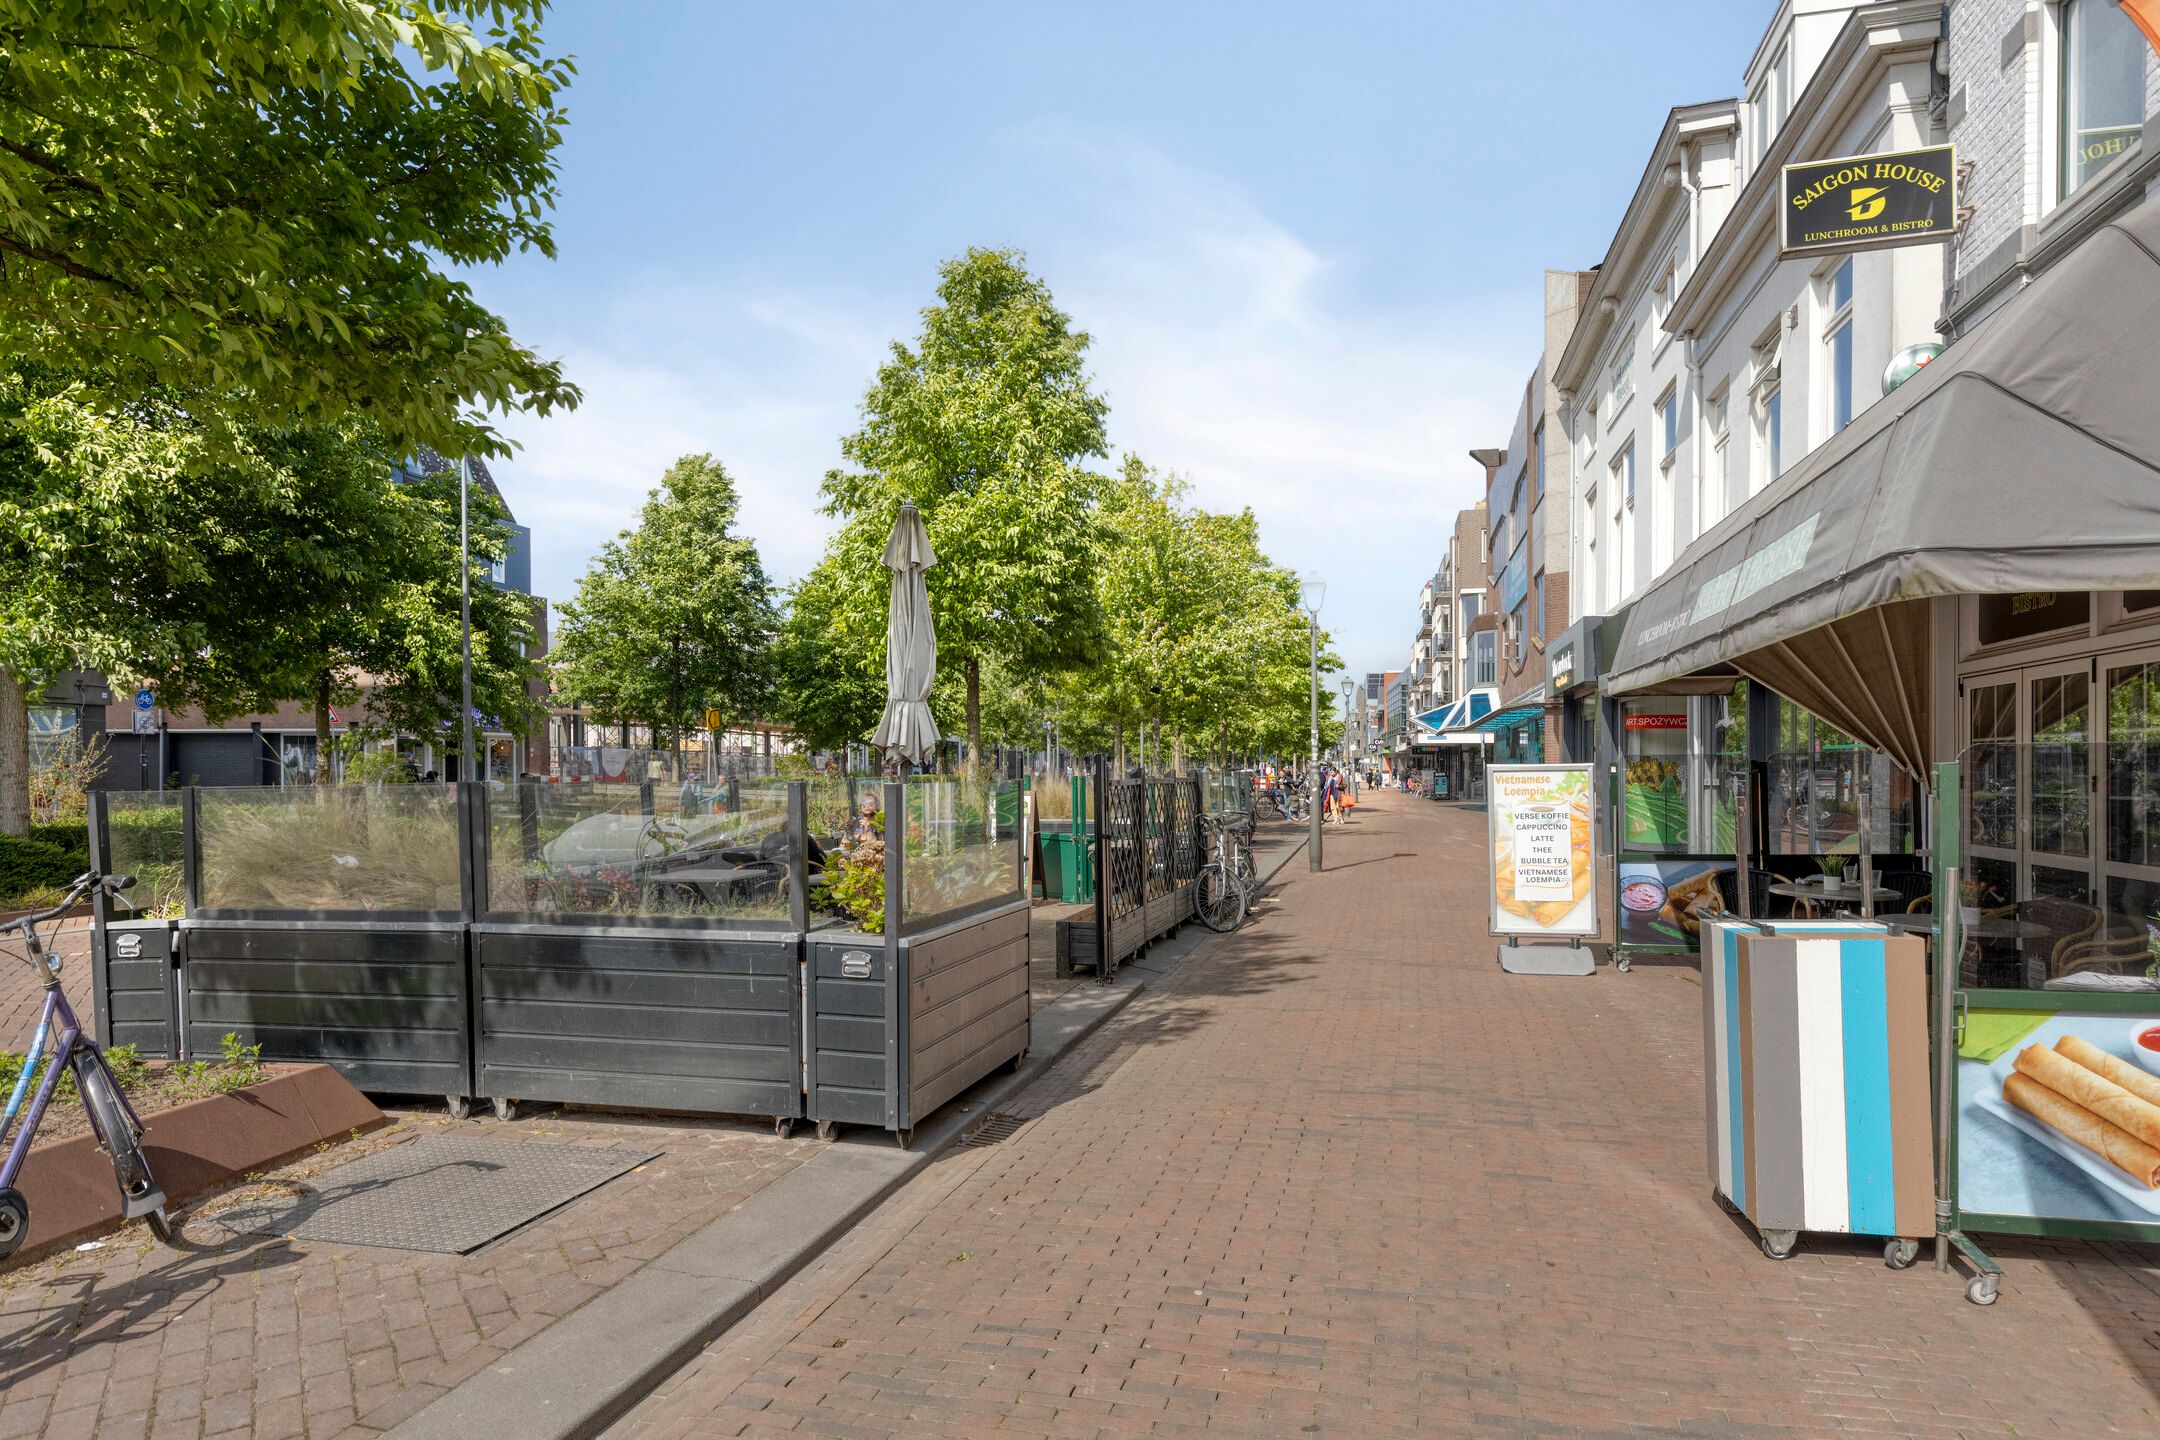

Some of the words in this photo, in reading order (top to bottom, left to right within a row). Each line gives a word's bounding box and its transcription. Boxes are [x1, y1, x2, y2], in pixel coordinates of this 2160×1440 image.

[1792, 164, 1868, 211] SAIGON
[1873, 163, 1946, 194] HOUSE
[1804, 225, 1879, 242] LUNCHROOM
[1880, 223, 1889, 233] &
[1891, 218, 1934, 232] BISTRO
[1495, 774, 1551, 784] Vietnamese
[1504, 787, 1546, 797] Loempia
